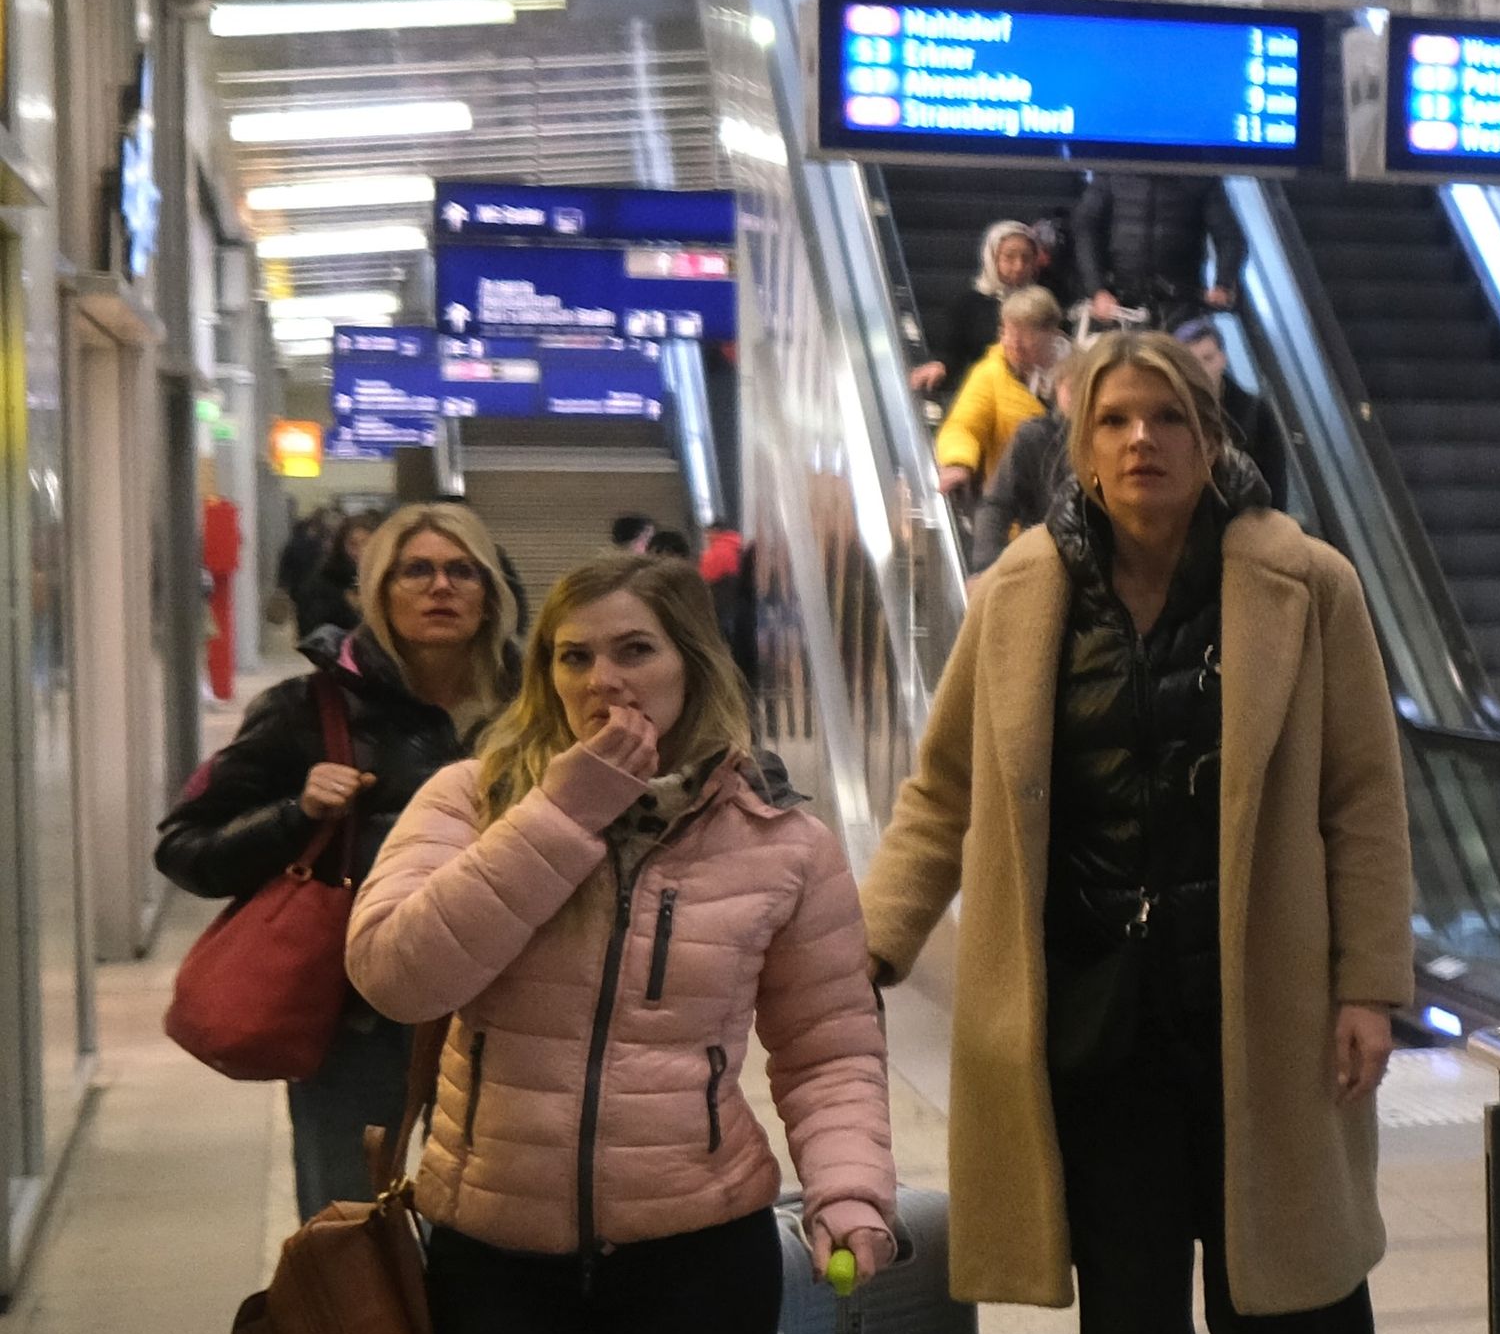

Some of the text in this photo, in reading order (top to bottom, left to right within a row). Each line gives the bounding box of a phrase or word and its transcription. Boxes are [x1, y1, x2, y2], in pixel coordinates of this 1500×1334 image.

[903, 6, 1012, 43] Mahlsdorf
[1266, 34, 1298, 58] min
[903, 37, 975, 70] Erkner
[1266, 62, 1298, 87] min
[903, 67, 1032, 103] Ahrensfelde
[1265, 91, 1297, 116] min
[903, 97, 1019, 137] Strausberg
[1020, 102, 1075, 134] Nord
[1264, 120, 1296, 144] min
